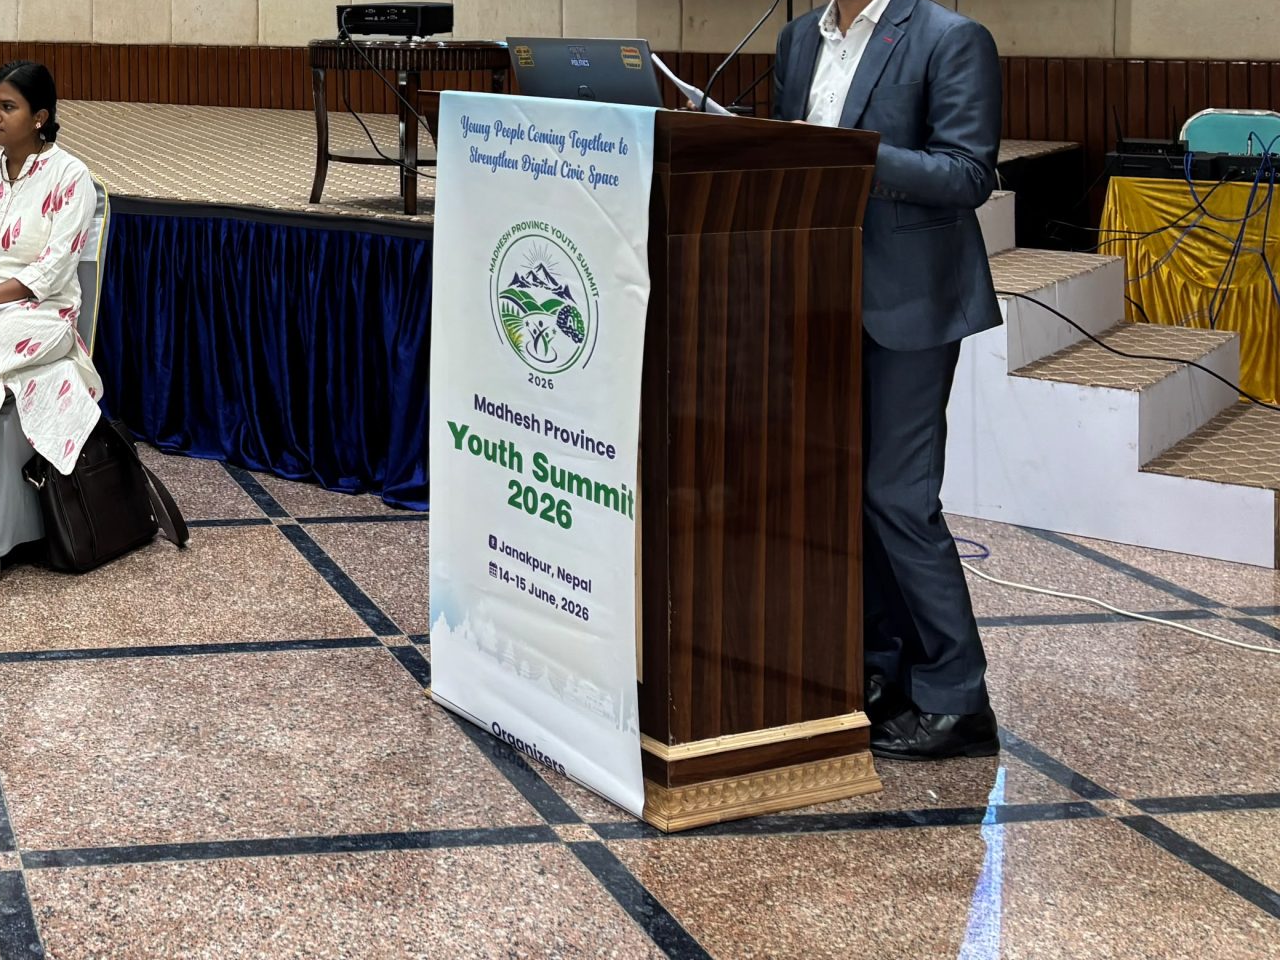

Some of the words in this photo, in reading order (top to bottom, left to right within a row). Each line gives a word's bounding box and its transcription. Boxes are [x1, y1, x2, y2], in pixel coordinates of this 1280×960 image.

[460, 115, 491, 142] Young
[493, 119, 525, 145] People
[527, 124, 566, 153] Coming
[569, 130, 615, 157] Together
[618, 136, 628, 155] to
[469, 145, 518, 173] Strengthen
[521, 154, 558, 180] Digital
[560, 160, 585, 181] Civic
[588, 164, 619, 190] Space
[489, 230, 512, 273] MADHESH
[511, 220, 550, 235] PROVINCE
[550, 226, 578, 253] YOUTH
[576, 253, 600, 298] SUMMIT
[528, 372, 554, 390] 2026
[474, 393, 540, 434] Madhesh
[544, 419, 616, 460] Province
[447, 420, 523, 474] Youth
[532, 451, 634, 521] Summit
[507, 479, 573, 530] 2026
[499, 540, 555, 579] Janakpur,
[557, 566, 592, 593] Nepal
[499, 566, 526, 591] 14-15
[528, 582, 559, 609] June,
[561, 597, 589, 621] 2026
[491, 721, 567, 776] Organizers
